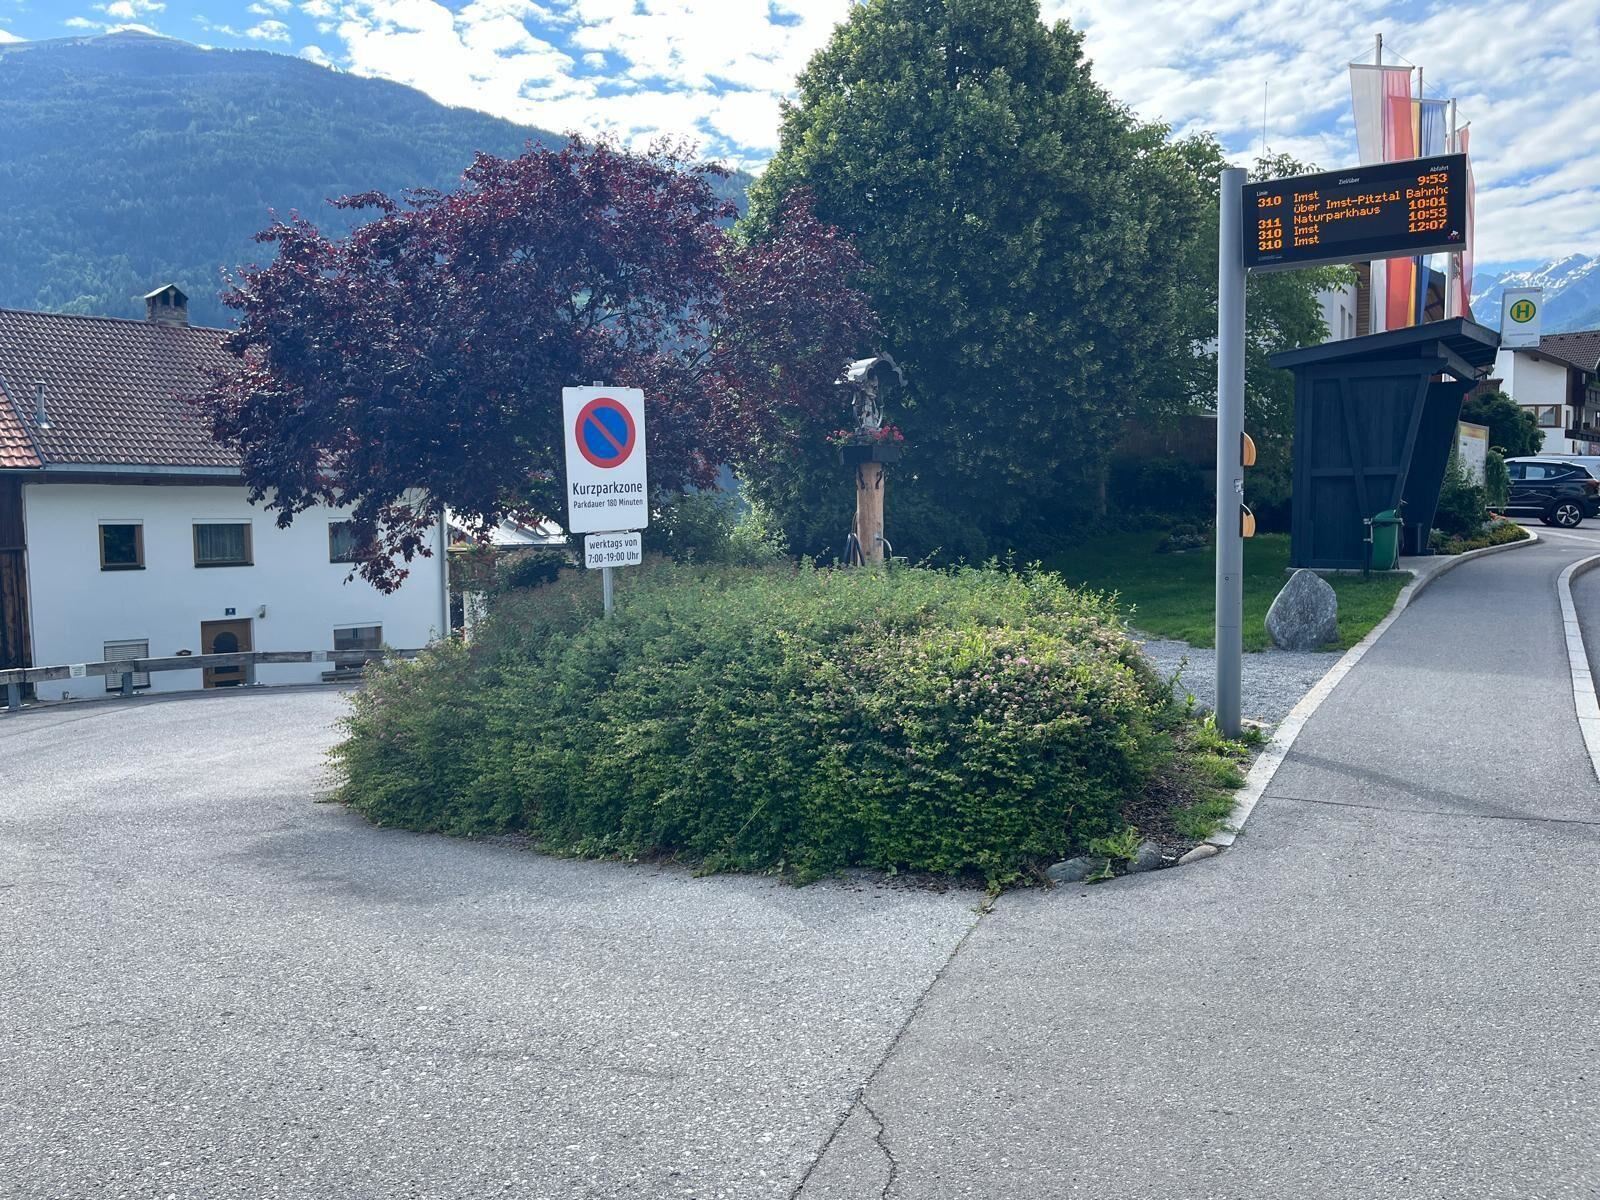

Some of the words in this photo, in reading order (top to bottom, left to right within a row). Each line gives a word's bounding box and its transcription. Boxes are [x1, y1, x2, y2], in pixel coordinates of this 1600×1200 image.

[1257, 195, 1282, 208] 310
[1293, 190, 1320, 203] Imst
[1417, 173, 1448, 186] 9:53
[1326, 190, 1400, 210] Imst-Pitztal
[1258, 218, 1282, 229] 311
[1293, 206, 1381, 225] Naturparkhaus
[1408, 196, 1447, 210] 10:01
[1258, 228, 1283, 240] 310
[1293, 223, 1320, 236] Imst
[1408, 207, 1448, 221] 10:53
[1258, 239, 1283, 251] 310
[1293, 234, 1320, 247] Imst
[1408, 218, 1447, 233] 12:07
[572, 481, 643, 497] Kurzparkzone
[573, 500, 605, 509] Parkdauer
[607, 498, 617, 507] 180
[618, 498, 643, 506] Minuten
[589, 539, 623, 550] werktags
[624, 538, 638, 547] von
[588, 551, 625, 564] 7:00-19:00
[626, 551, 640, 561] Uhr
